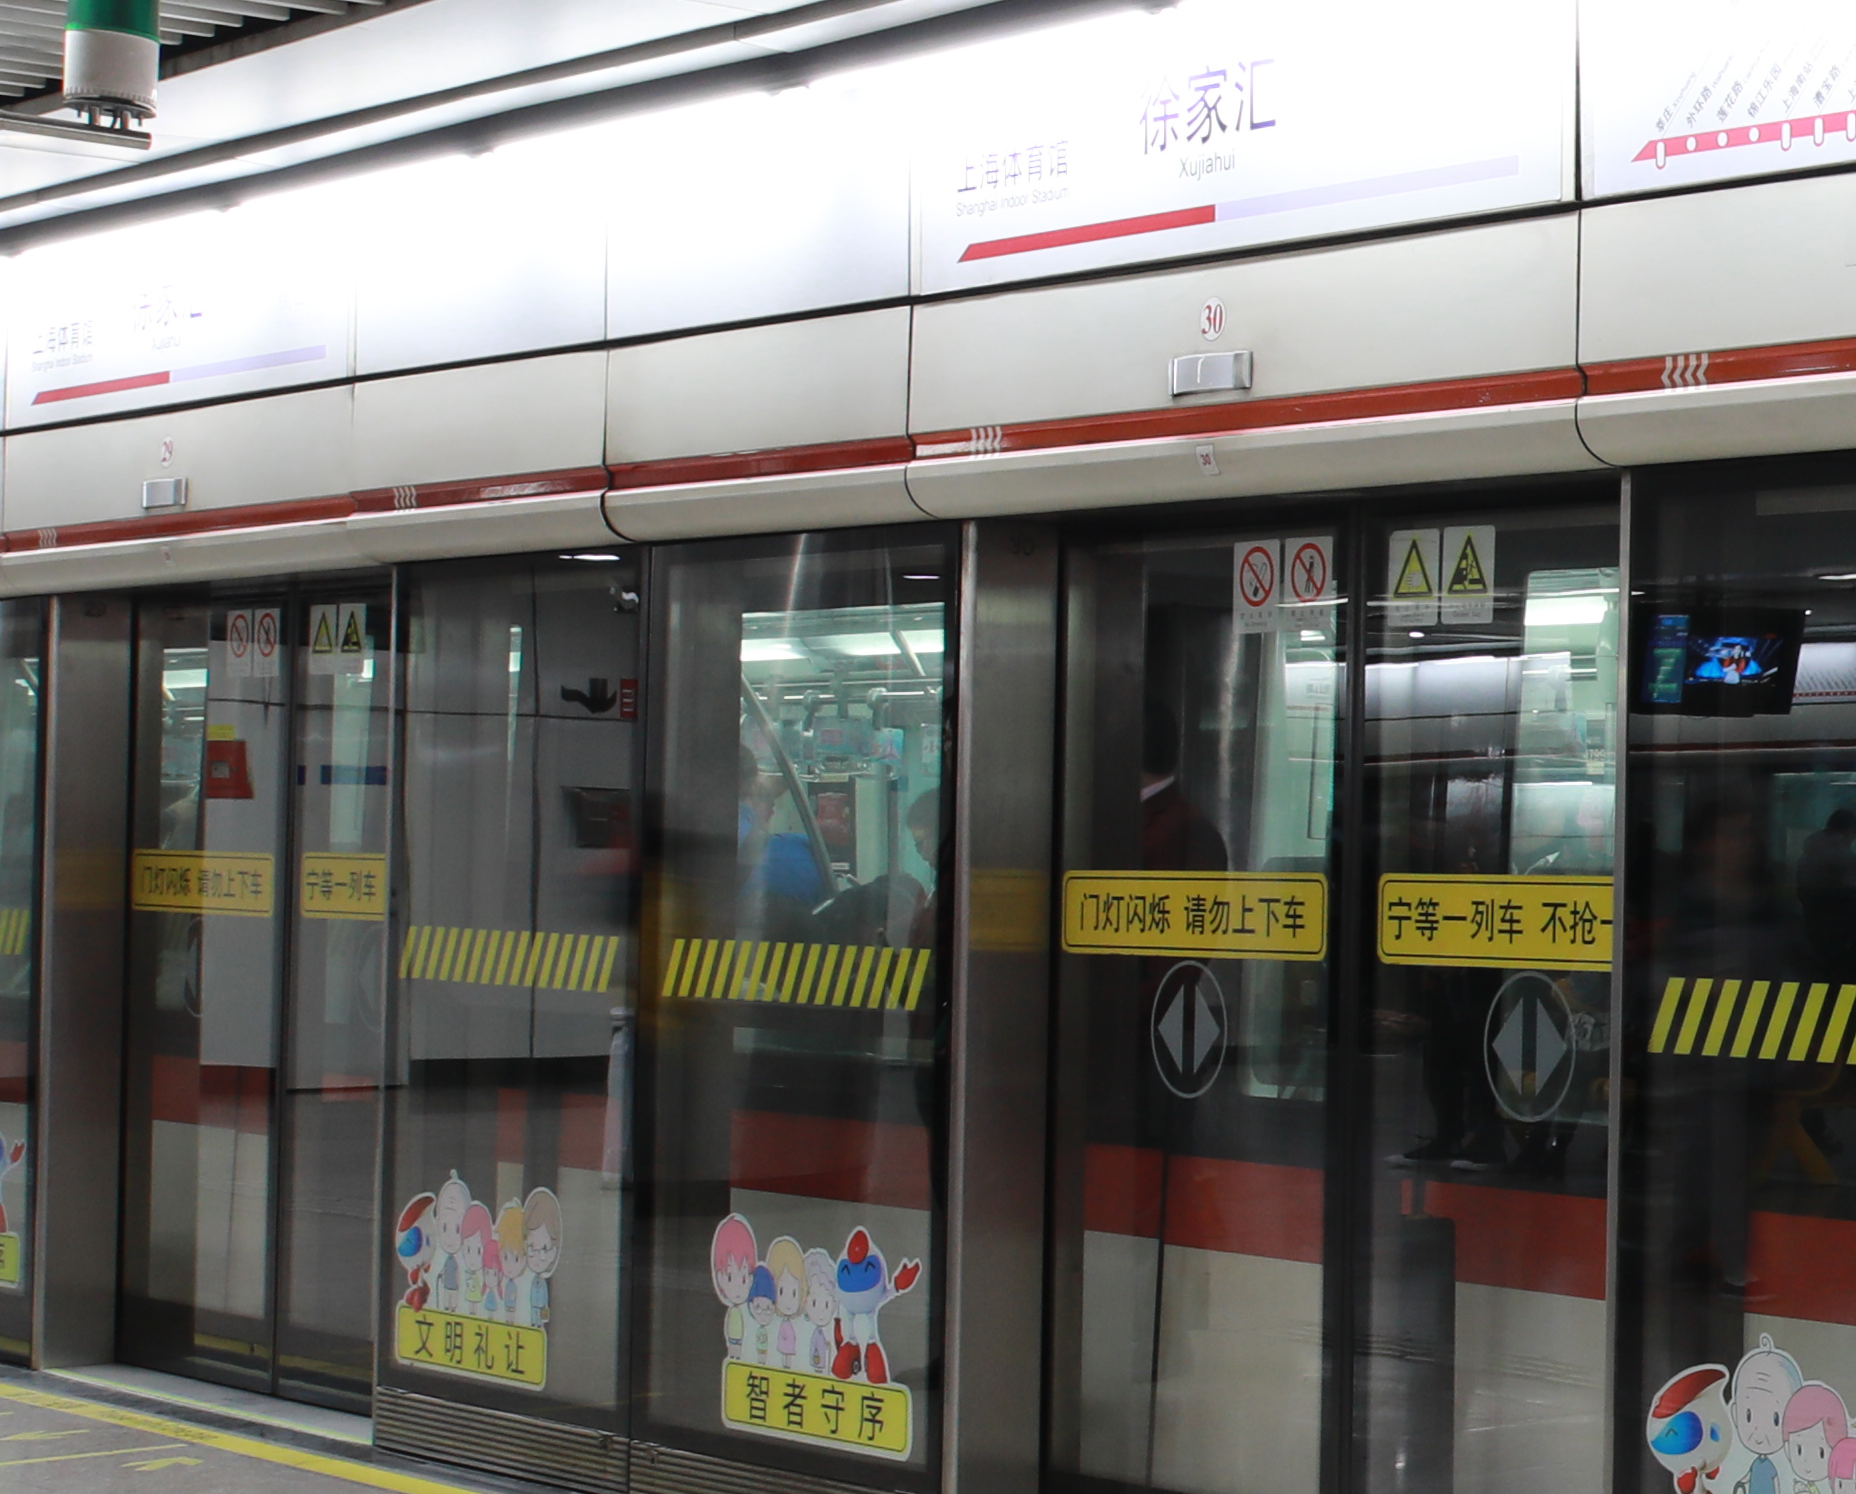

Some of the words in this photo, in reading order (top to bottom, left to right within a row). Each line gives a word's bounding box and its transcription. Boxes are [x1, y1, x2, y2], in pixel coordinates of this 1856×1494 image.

[1139, 58, 1276, 155] 徐家汇
[957, 139, 1069, 193] 上海体育馆
[1179, 148, 1235, 181] Xujiahui
[1201, 304, 1223, 335] 30
[306, 868, 377, 902] 宁等一列车
[1080, 892, 1171, 936] 门灯闪烁
[1184, 894, 1306, 939] 请勿上下车
[1387, 895, 1525, 945] 宁等一列车
[414, 1313, 526, 1377] 文明礼让
[746, 1370, 886, 1442] 智者守序
